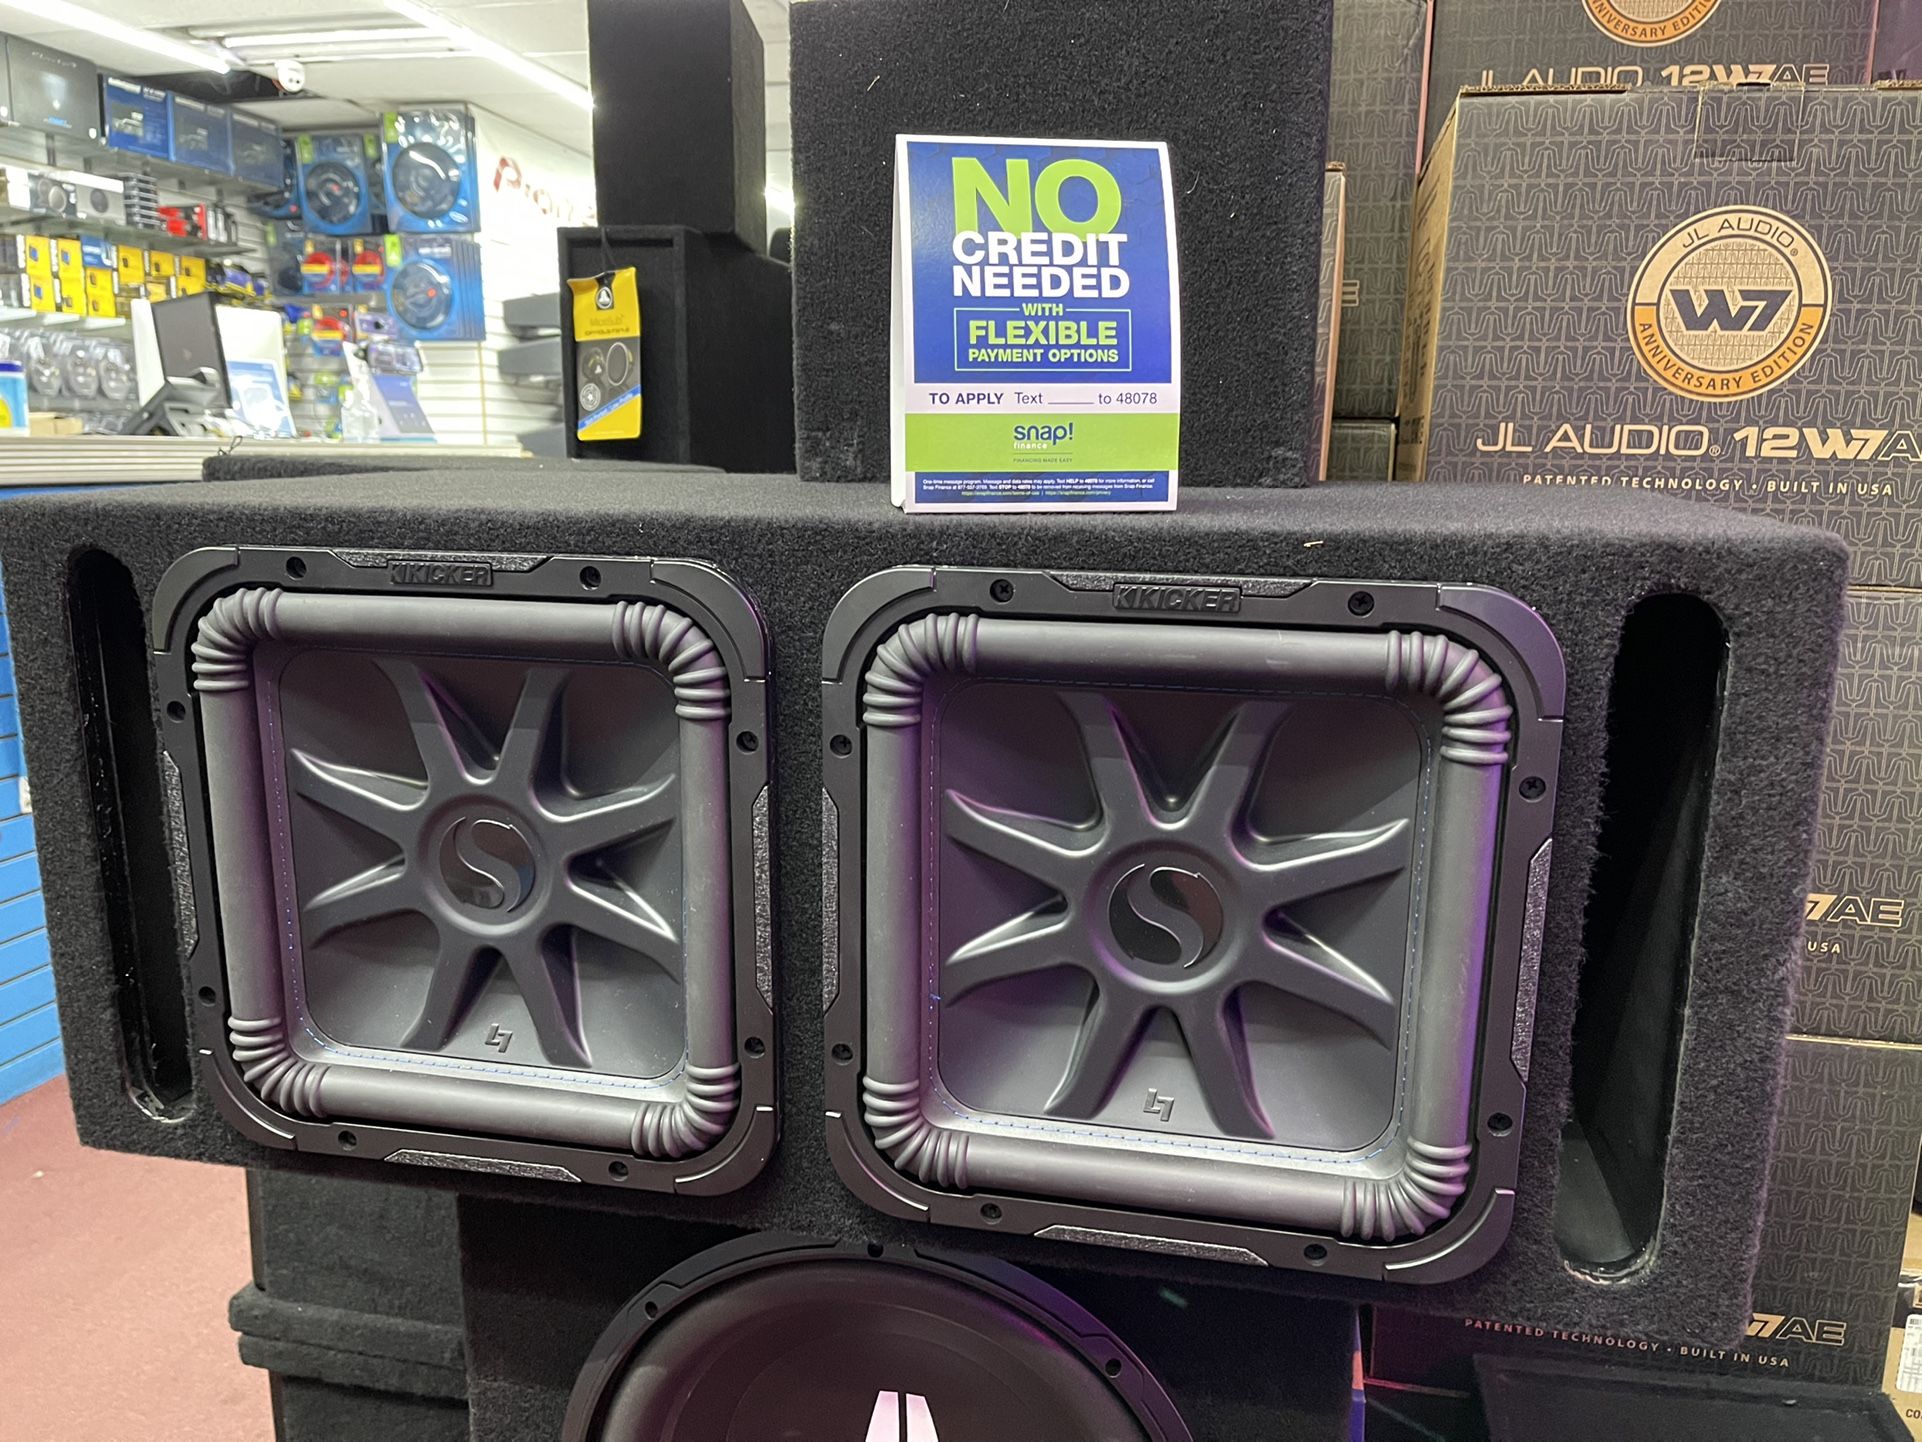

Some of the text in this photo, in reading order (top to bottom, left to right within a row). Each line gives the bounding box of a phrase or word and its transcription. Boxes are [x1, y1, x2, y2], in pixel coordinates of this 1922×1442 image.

[1522, 65, 1643, 87] AUDIO
[952, 157, 1122, 241] NO
[952, 230, 1128, 266] CREDIT
[1682, 228, 1709, 249] JL
[952, 265, 1130, 298] NEEDED
[1022, 303, 1064, 316] WITH
[1669, 288, 1794, 332] W7
[969, 320, 1118, 345] FLEXIBLE
[968, 348, 1119, 363] PAYMENT OPTIONS
[1639, 322, 1814, 391] ANNIVERSARY EDITION
[929, 392, 1158, 405] TO APPLY Text to 48078
[1013, 422, 1073, 445] snap!
[1476, 422, 1533, 452] JL
[1523, 474, 1893, 496] PATENTED TECHNOLOGY BUILT IN USA
[1804, 893, 1905, 928] 7AE
[1807, 941, 1841, 954] USA
[1745, 1312, 1848, 1346] 7AE
[1464, 1318, 1790, 1368] PATENTED TECHNOLOGY BUILT IN USA
